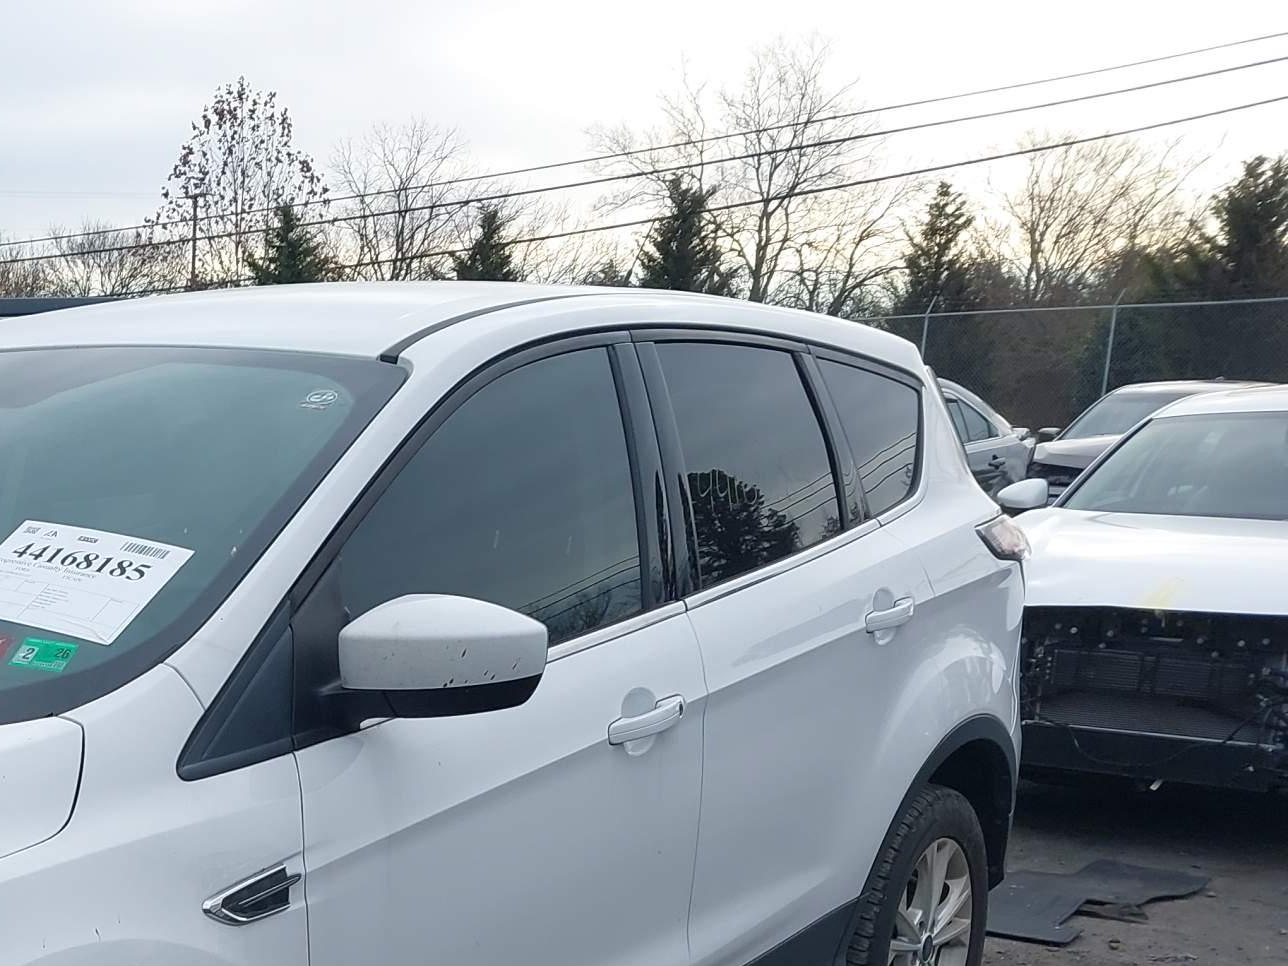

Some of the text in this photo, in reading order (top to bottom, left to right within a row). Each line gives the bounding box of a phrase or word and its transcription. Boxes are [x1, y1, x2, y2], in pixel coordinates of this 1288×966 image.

[13, 542, 152, 581] 44168185
[22, 647, 72, 660] 2 26
